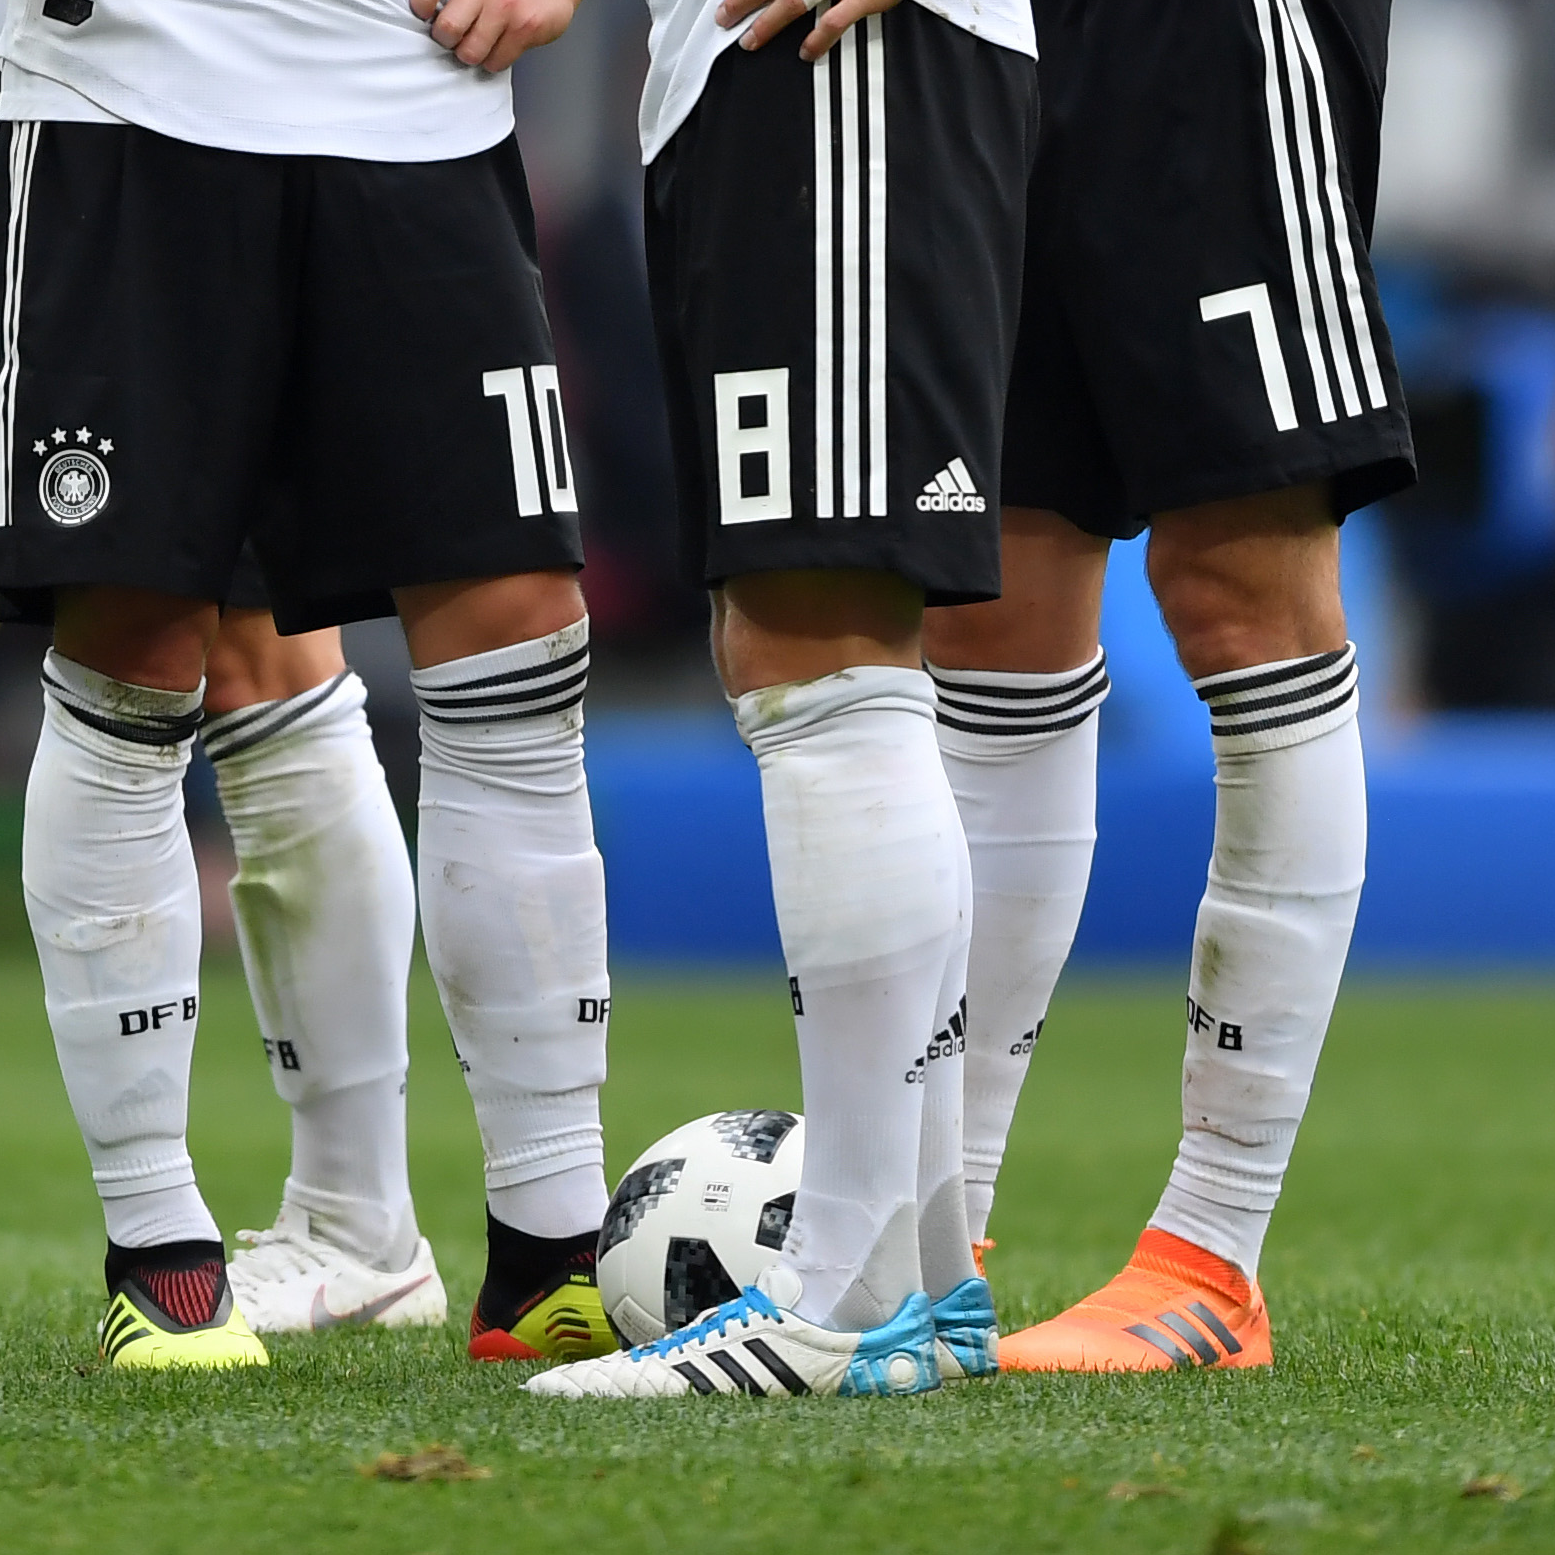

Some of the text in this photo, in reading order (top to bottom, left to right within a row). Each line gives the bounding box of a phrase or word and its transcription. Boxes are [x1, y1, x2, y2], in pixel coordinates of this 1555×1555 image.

[1199, 283, 1299, 432] 7
[483, 365, 578, 517] 10
[714, 367, 792, 525] 8
[54, 459, 94, 474] DEUTSCHER
[916, 492, 986, 512] adidas
[119, 996, 196, 1036] DFB
[577, 998, 611, 1023] DF
[1187, 995, 1242, 1051] DFB
[263, 1038, 301, 1071] FB
[927, 1037, 965, 1060] adid
[707, 1184, 730, 1192] FIFA
